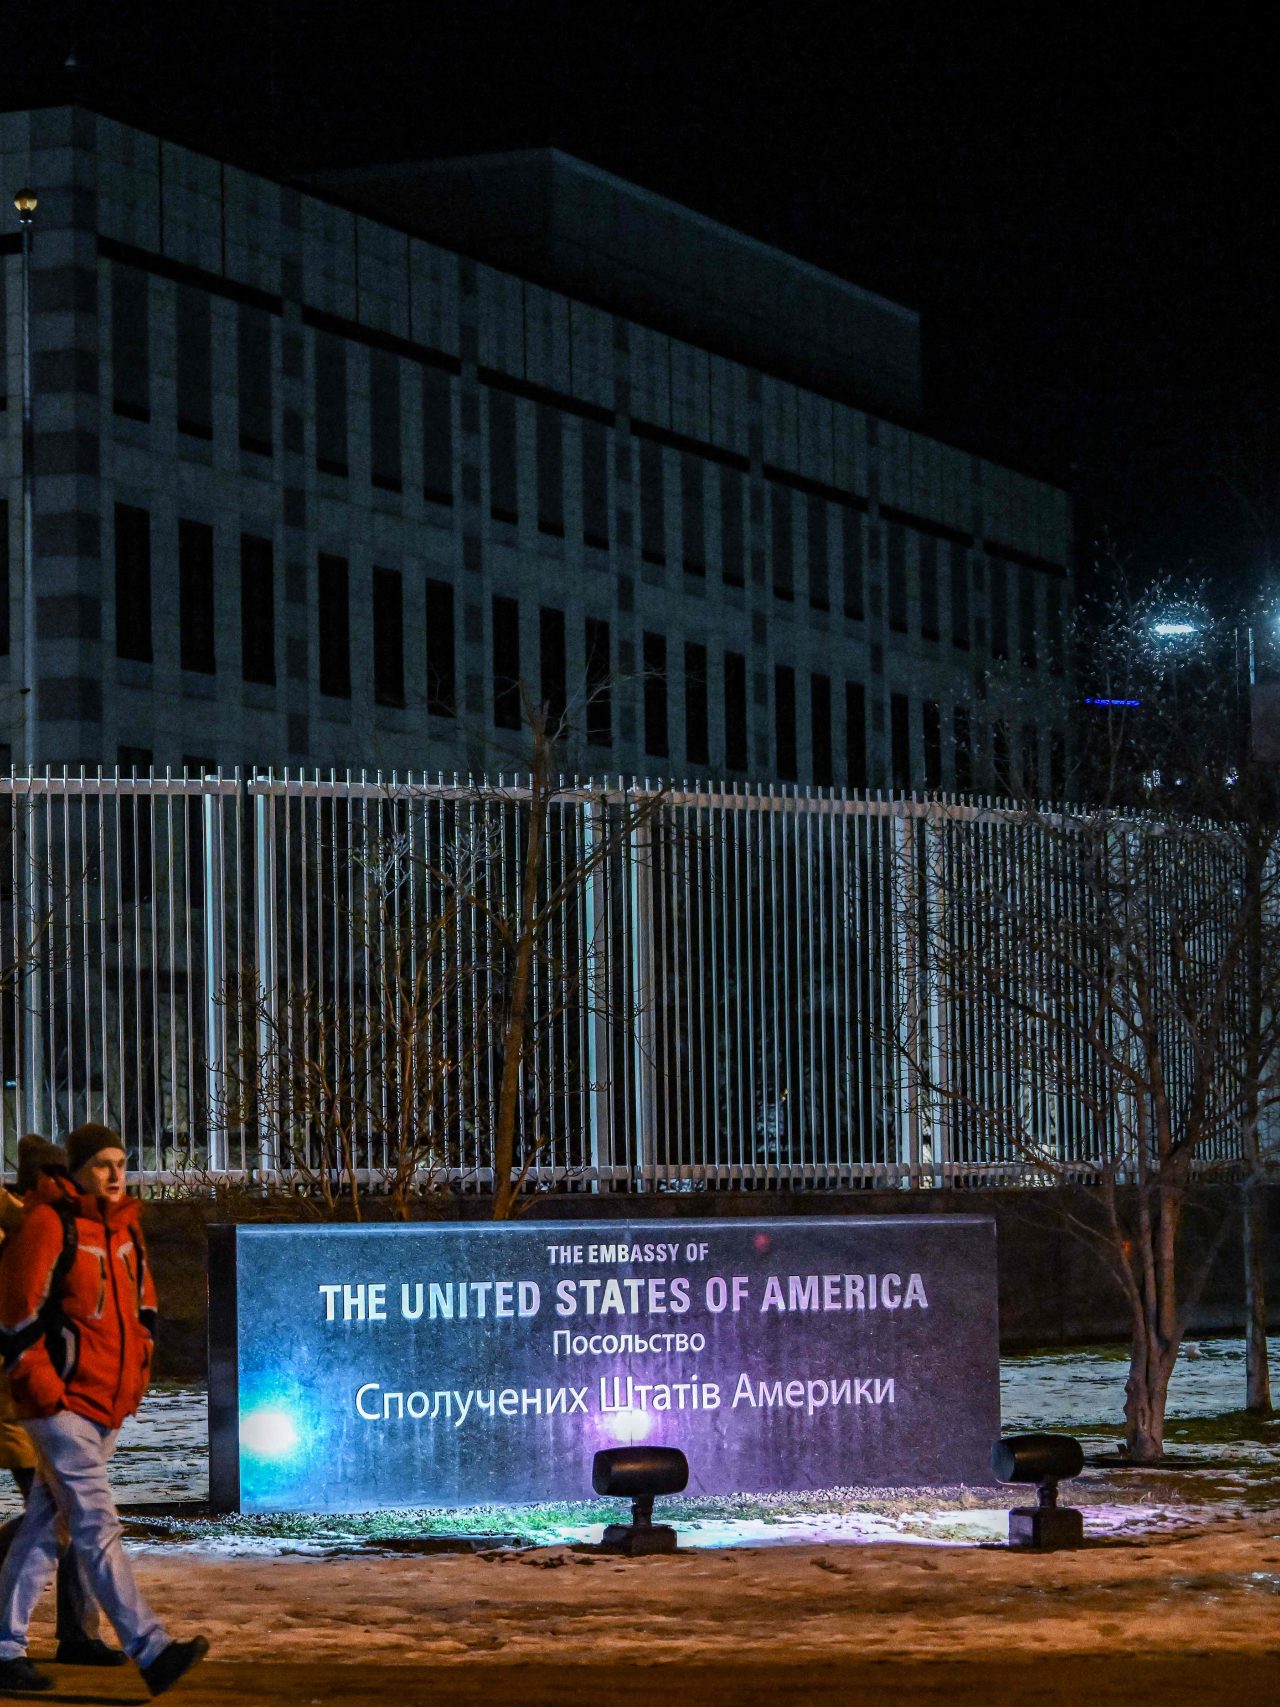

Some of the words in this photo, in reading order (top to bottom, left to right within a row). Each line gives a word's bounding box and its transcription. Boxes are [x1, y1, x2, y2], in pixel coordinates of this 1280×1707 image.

[547, 1245, 584, 1265] THE
[588, 1243, 680, 1264] EMBASSY
[686, 1242, 709, 1262] OF
[318, 1283, 387, 1321] THE
[400, 1281, 541, 1319] UNITED
[555, 1277, 691, 1316] STATES
[705, 1276, 749, 1313] OF
[760, 1273, 928, 1312] AMERICA
[553, 1330, 706, 1355] Посольство
[355, 1383, 589, 1427] Сполучених
[600, 1374, 721, 1412] Штатів
[731, 1373, 895, 1416] Америки
